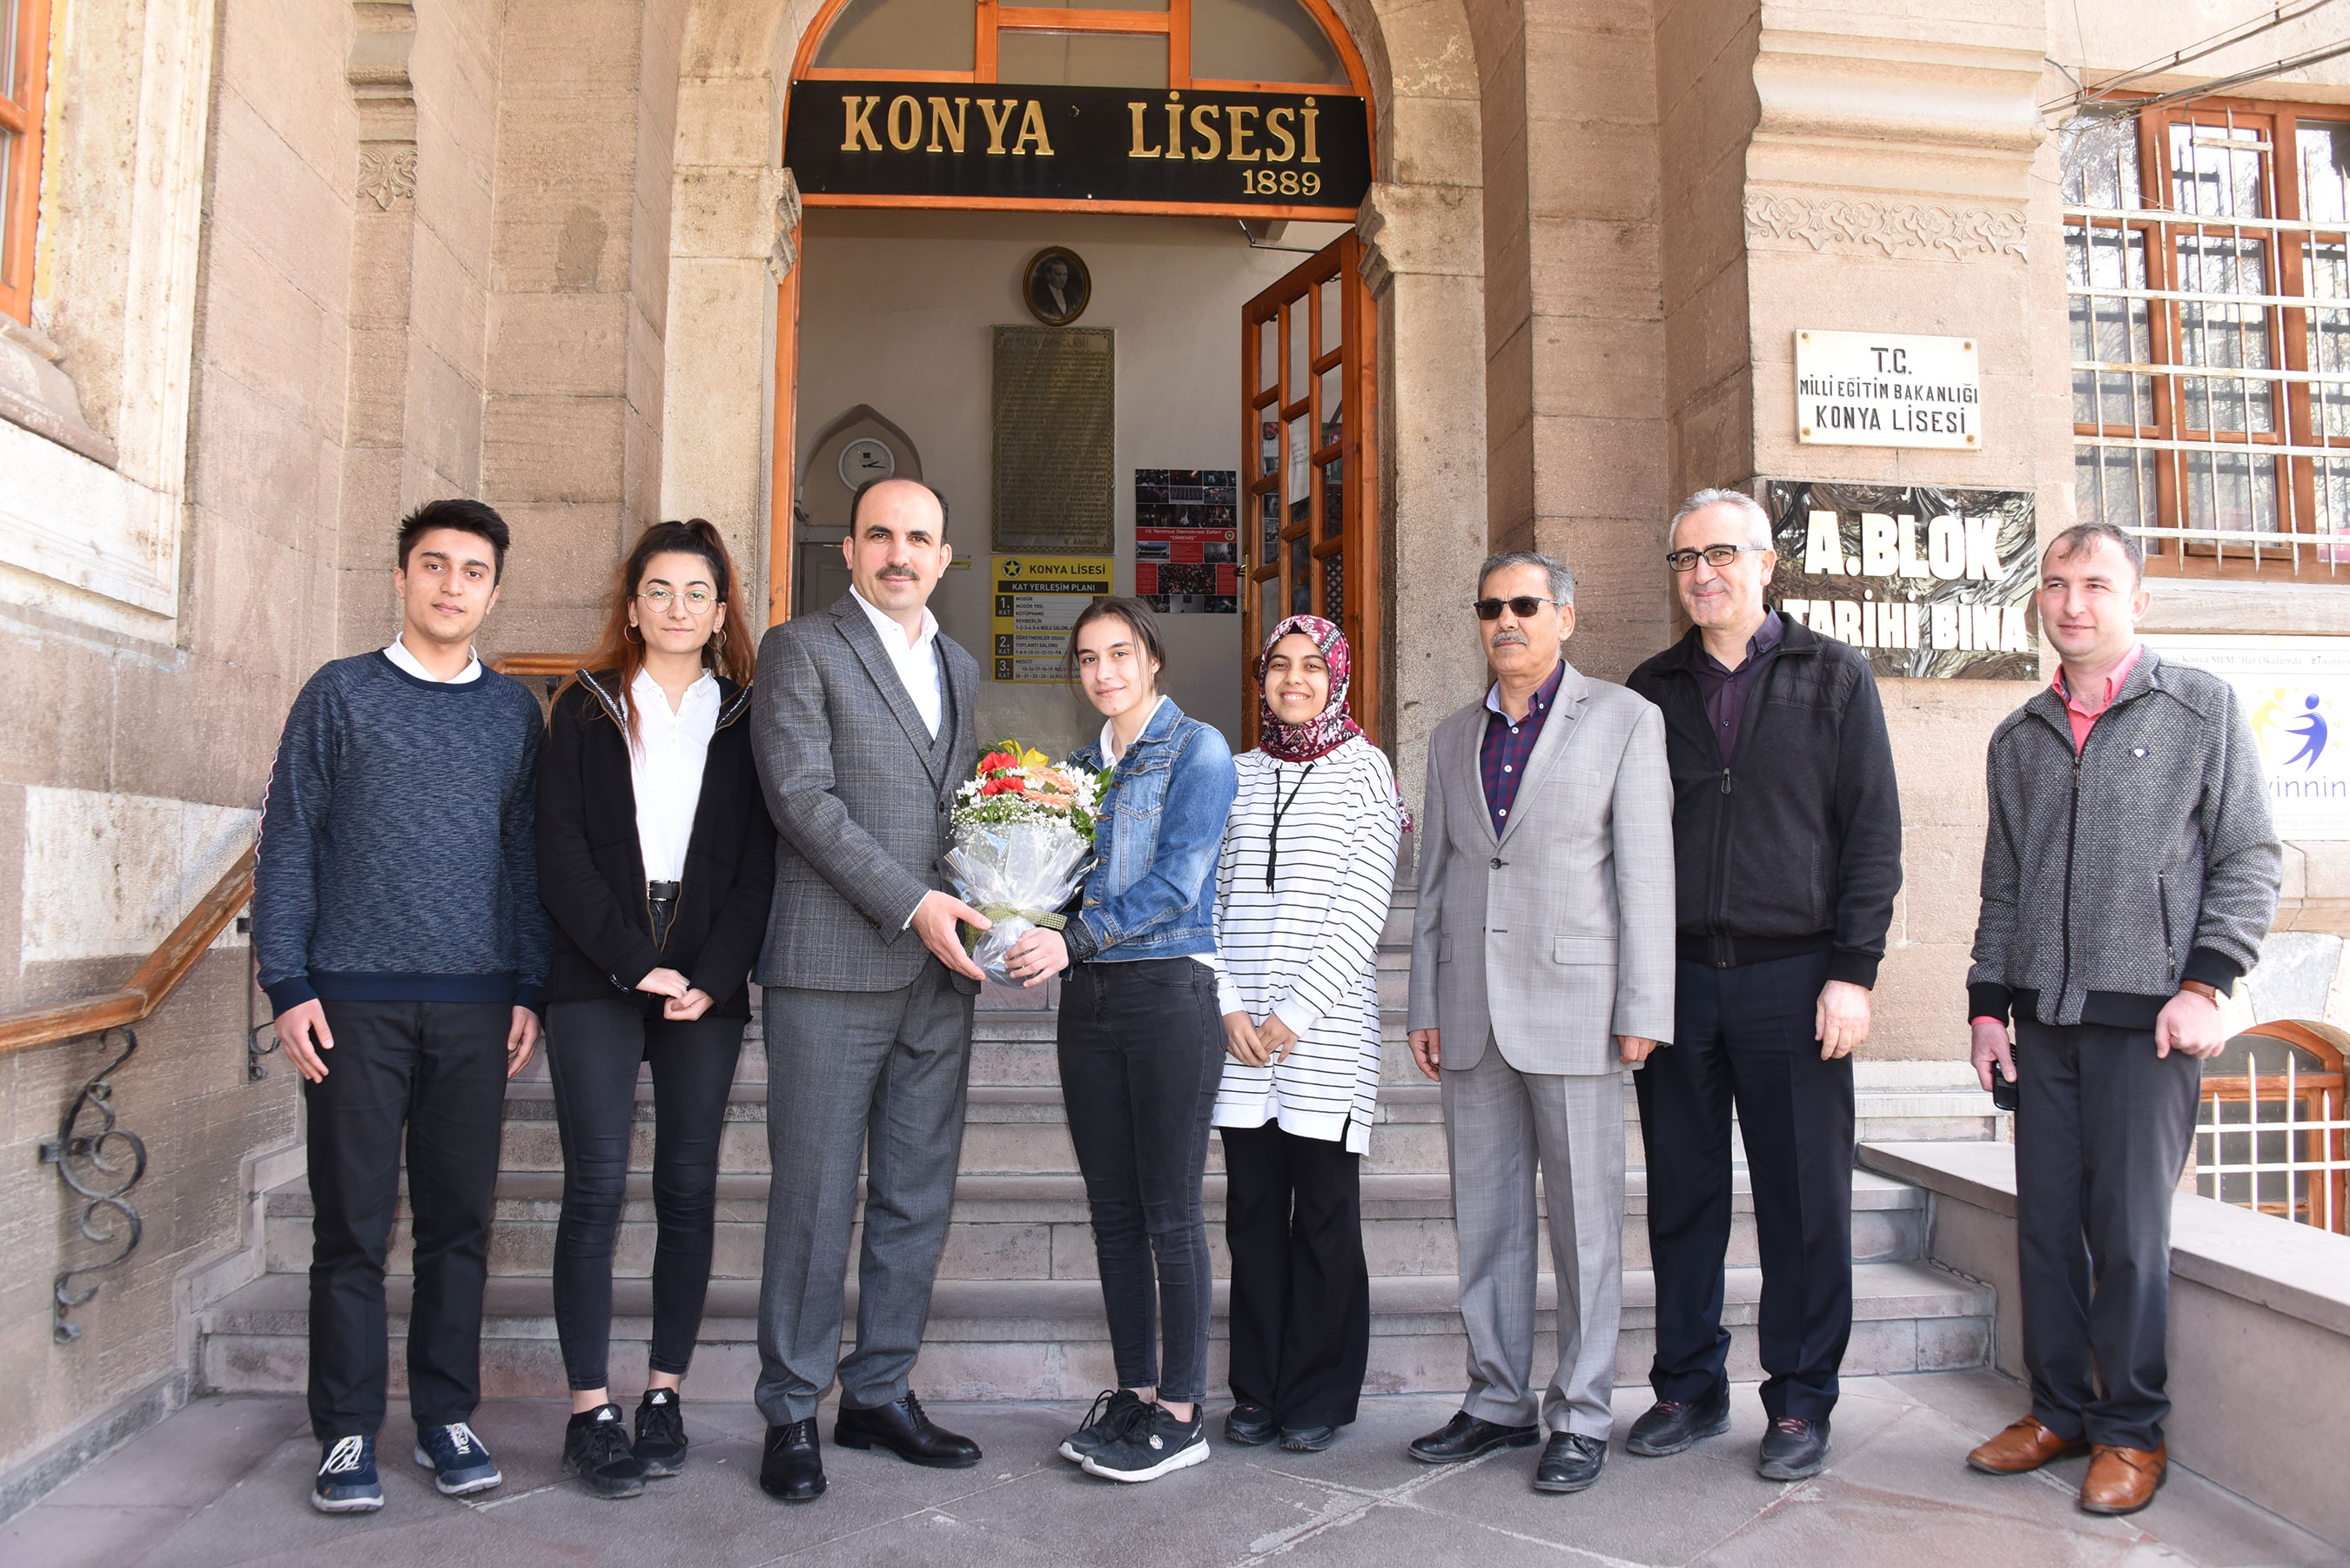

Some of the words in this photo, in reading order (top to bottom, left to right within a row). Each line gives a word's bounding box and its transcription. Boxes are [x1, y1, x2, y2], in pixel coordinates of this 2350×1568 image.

[841, 95, 1055, 157] KONYA
[1127, 90, 1321, 164] LİSESİ
[1242, 169, 1321, 197] 1889
[1870, 347, 1913, 376] T.C.
[1799, 373, 1834, 398] MİLLİ
[1836, 376, 1889, 400] EĞİTİM
[1894, 383, 1978, 405] BAKANLIĞI
[1816, 405, 1882, 431] KONYA
[1892, 405, 1966, 435] LİSESİ
[1803, 510, 2004, 581] A.BLOK
[1030, 565, 1067, 574] KONYA
[1071, 563, 1105, 575] LİSESİ
[1029, 582, 1069, 593] YERLEŞİM
[1000, 597, 1010, 608] 1.
[1782, 589, 1920, 649] TARİHİ
[1930, 593, 2030, 653] BİNA
[999, 635, 1010, 647] 2.
[999, 660, 1010, 671] 3.
[2183, 655, 2209, 665] Konya
[2212, 655, 2234, 664] MEM
[2258, 657, 2302, 666] Okulumda
